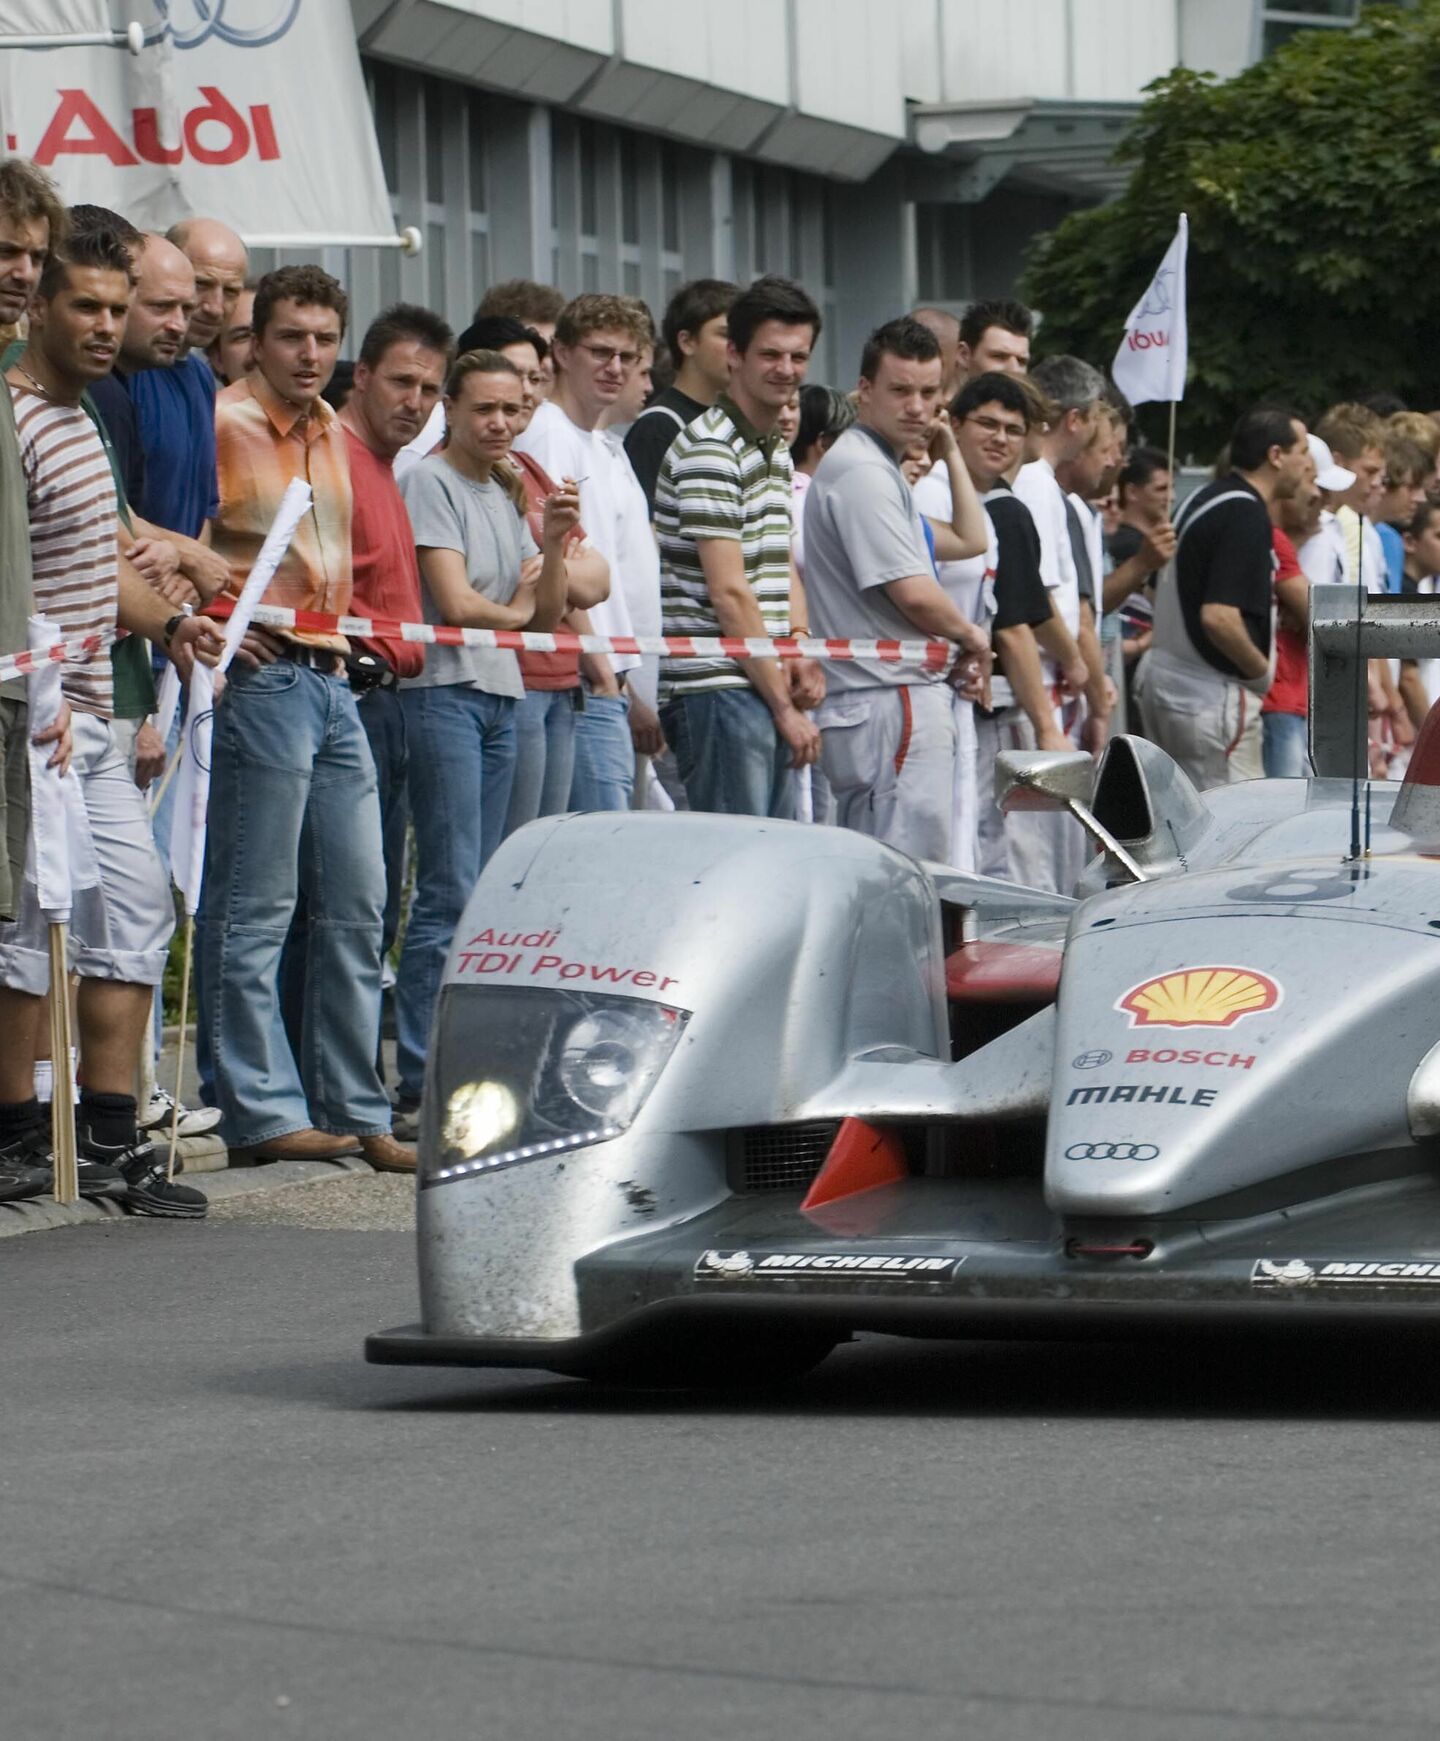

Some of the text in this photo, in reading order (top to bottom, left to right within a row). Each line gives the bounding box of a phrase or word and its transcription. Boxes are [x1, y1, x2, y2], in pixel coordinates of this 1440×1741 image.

[34, 86, 281, 166] Audi
[1226, 868, 1378, 902] 8
[467, 927, 562, 948] Audi
[457, 952, 680, 991] TDI Power
[1125, 1049, 1257, 1070] BOSCH
[1066, 1085, 1218, 1107] MAHLE
[757, 1254, 956, 1271] MICHELIN
